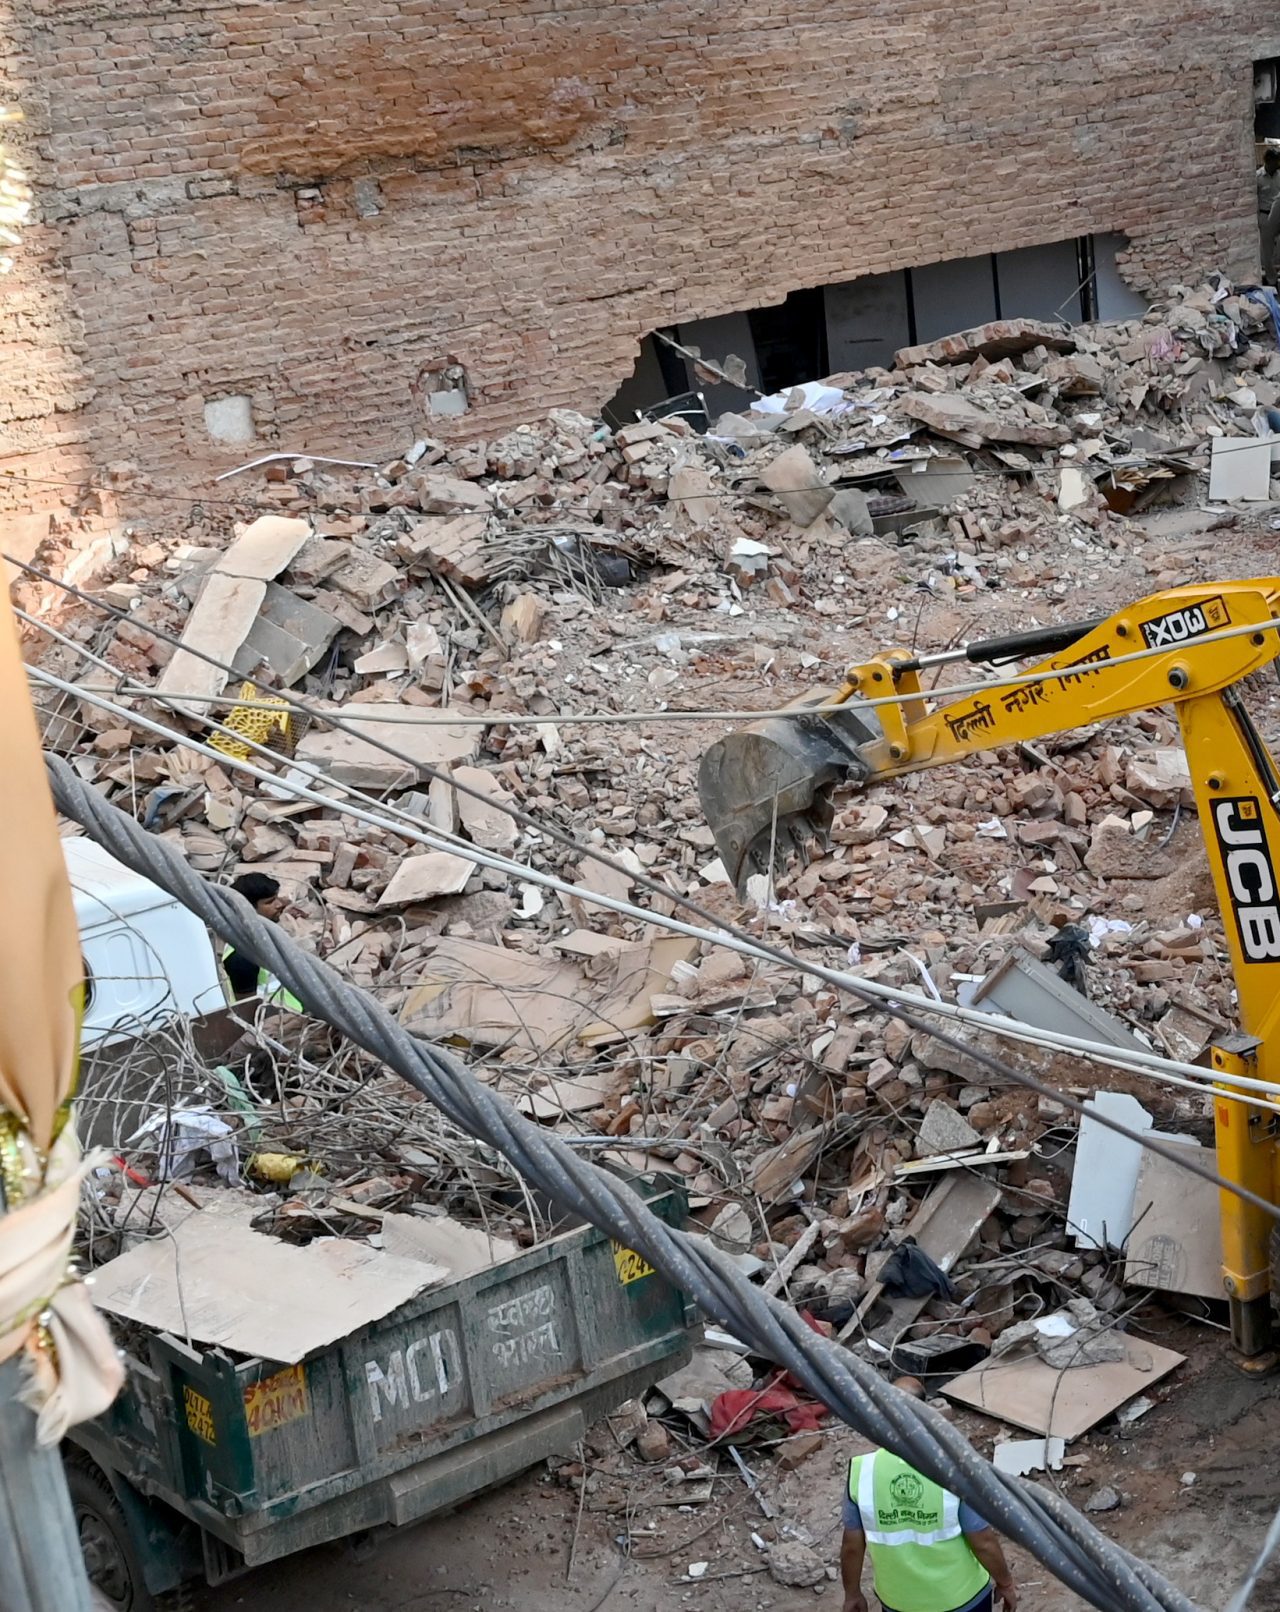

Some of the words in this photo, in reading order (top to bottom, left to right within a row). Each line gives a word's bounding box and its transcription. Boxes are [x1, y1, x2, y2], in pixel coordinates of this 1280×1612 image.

[944, 701, 995, 743] दिल्ली
[1000, 680, 1049, 712] नगर
[365, 1328, 463, 1422] MCD
